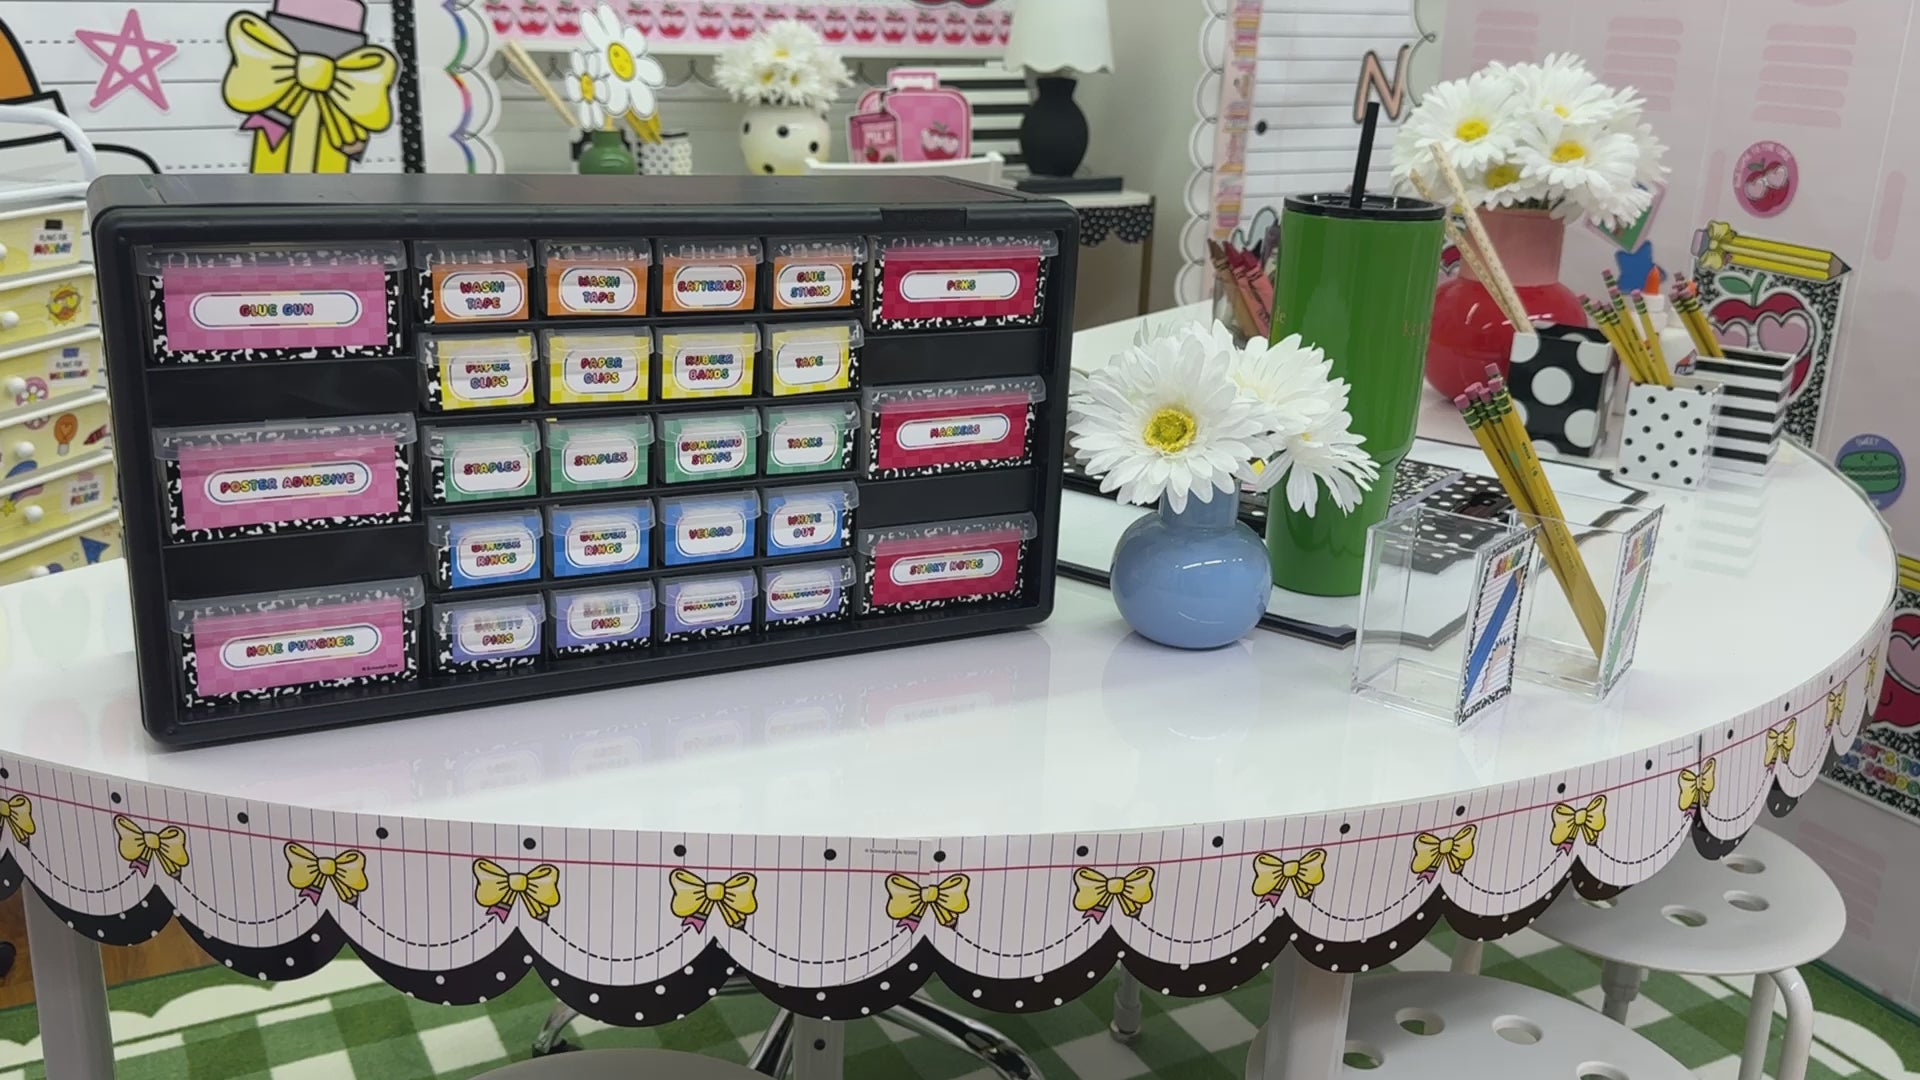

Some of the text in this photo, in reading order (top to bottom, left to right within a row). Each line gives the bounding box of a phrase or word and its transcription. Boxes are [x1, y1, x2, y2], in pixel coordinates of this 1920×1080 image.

[578, 275, 620, 288] WASHI
[796, 270, 825, 282] GLUE
[460, 280, 505, 294] WASHI
[677, 279, 742, 293] BATTERIES
[790, 285, 831, 298] STICKS
[946, 279, 977, 291] PENS
[465, 296, 501, 310] TAPE
[582, 291, 615, 304] TAPE
[239, 303, 314, 317] GLUE GUN
[465, 359, 511, 374] PAPER
[580, 356, 623, 369] PAPER
[685, 353, 734, 366] RUBBER
[795, 355, 824, 368] TAPE
[583, 371, 619, 384] CLIPS
[688, 368, 729, 381] BANDS
[470, 375, 508, 390] CLIPS
[929, 423, 981, 439] MARKERS
[681, 436, 743, 452] COMMAND
[787, 436, 823, 449] TACKS
[573, 452, 628, 466] STAPLES
[691, 451, 732, 466] STRIPS
[463, 460, 521, 475] STAPLES
[220, 472, 355, 494] POSTER ADHESIVE
[787, 512, 822, 526] WHITE
[688, 525, 733, 540] VELCRO
[793, 527, 816, 538] OUT
[584, 543, 623, 556] RINGS
[476, 552, 517, 567] RINGS
[909, 558, 984, 576] STICKY NOTES
[591, 616, 621, 631] PINS
[482, 632, 514, 646] PINS
[246, 635, 355, 658] HOLE PUNCHER
